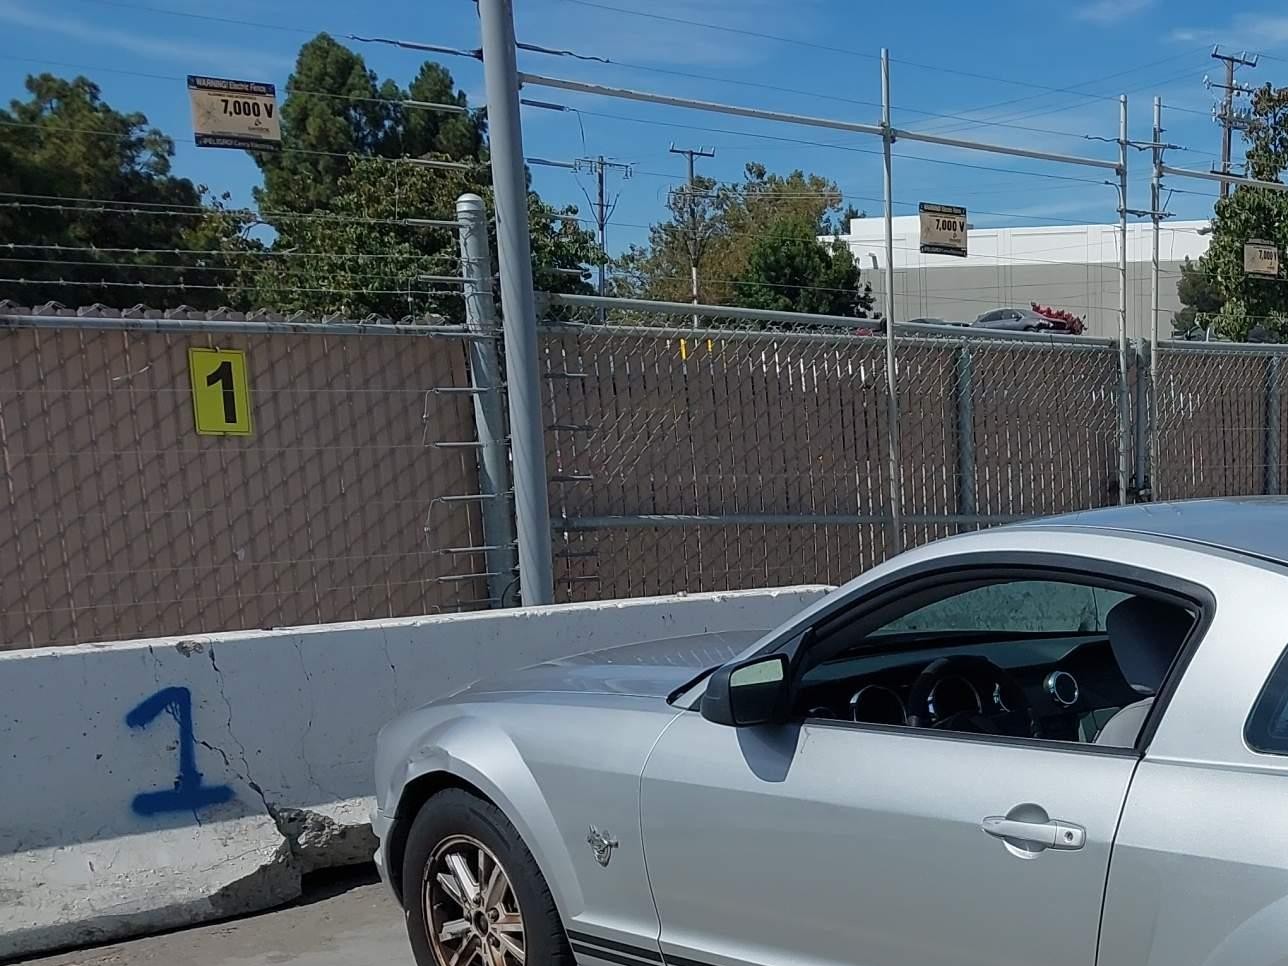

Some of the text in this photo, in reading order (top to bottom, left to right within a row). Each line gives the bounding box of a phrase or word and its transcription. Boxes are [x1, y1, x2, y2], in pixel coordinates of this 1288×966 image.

[221, 99, 274, 118] 7,000 V
[936, 219, 964, 232] 7,000 V
[206, 361, 237, 423] 1
[126, 686, 236, 817] 1
